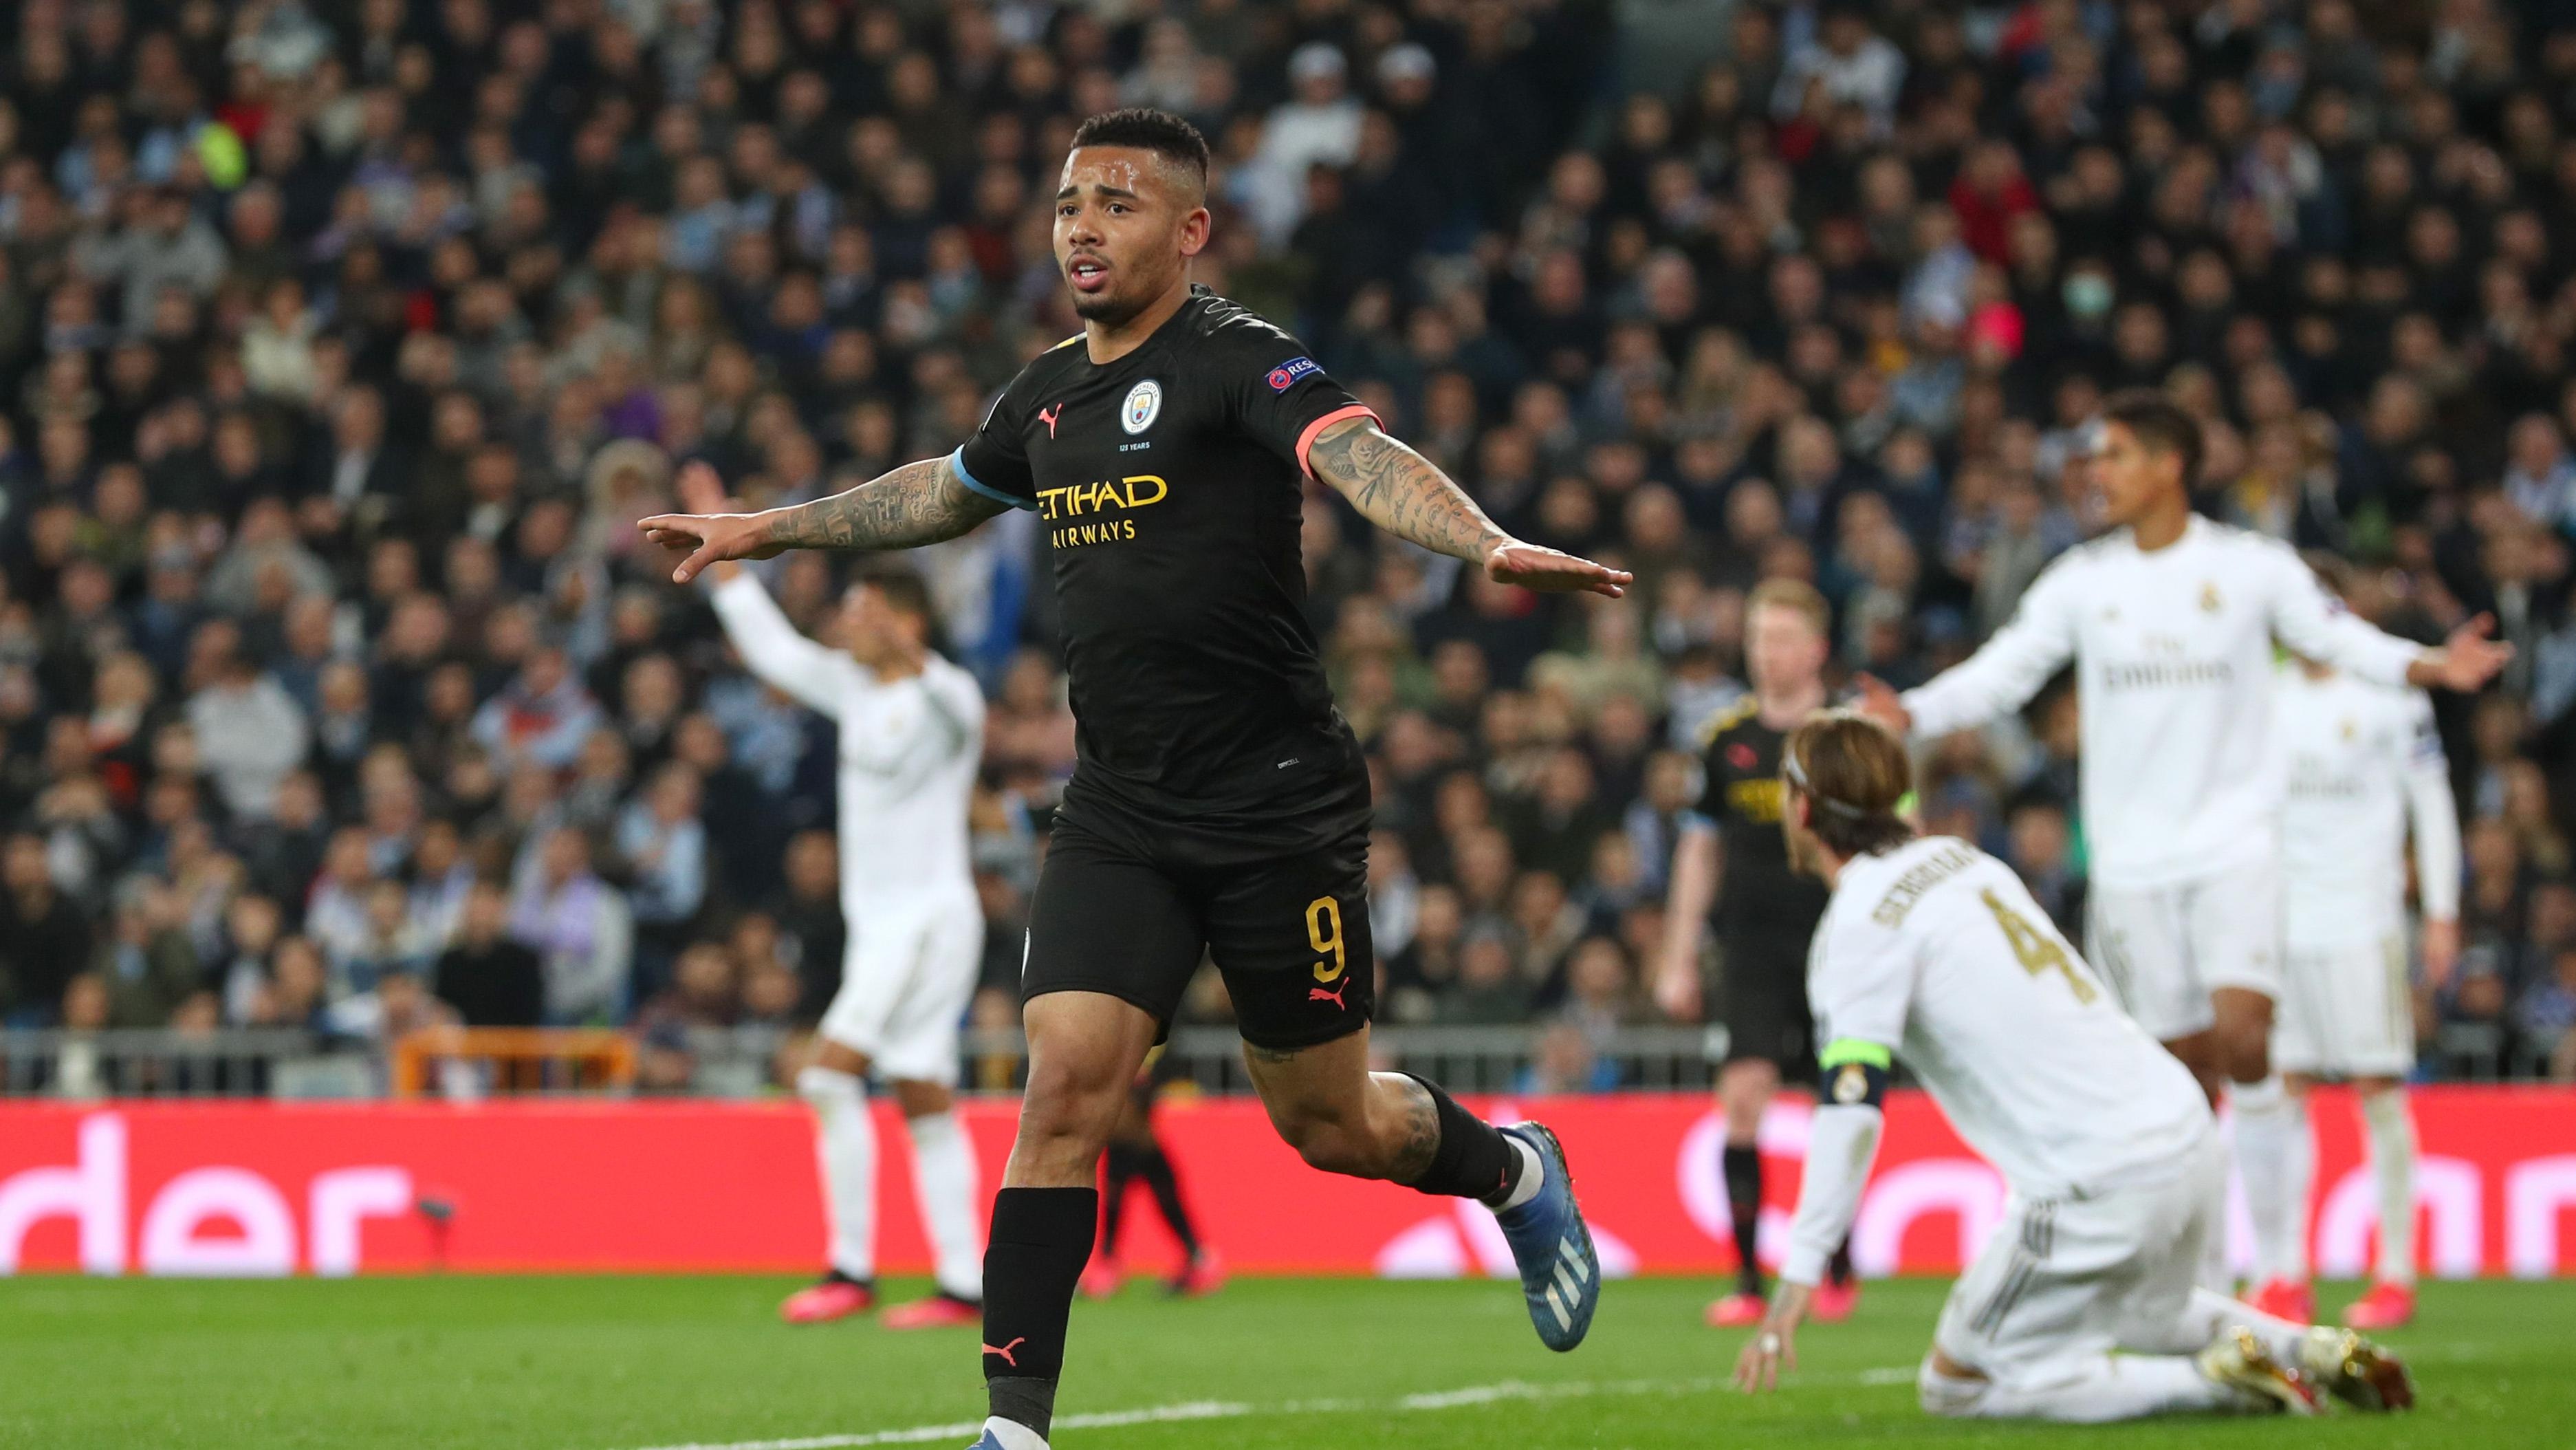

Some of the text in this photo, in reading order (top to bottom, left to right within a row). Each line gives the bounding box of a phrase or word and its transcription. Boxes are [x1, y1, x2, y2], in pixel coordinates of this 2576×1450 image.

[1288, 360, 1316, 376] RES
[1130, 442, 1150, 451] YEARS
[1053, 519, 1135, 549] AIRWAYS
[1306, 896, 1345, 983] 9
[1979, 888, 2097, 1005] 4
